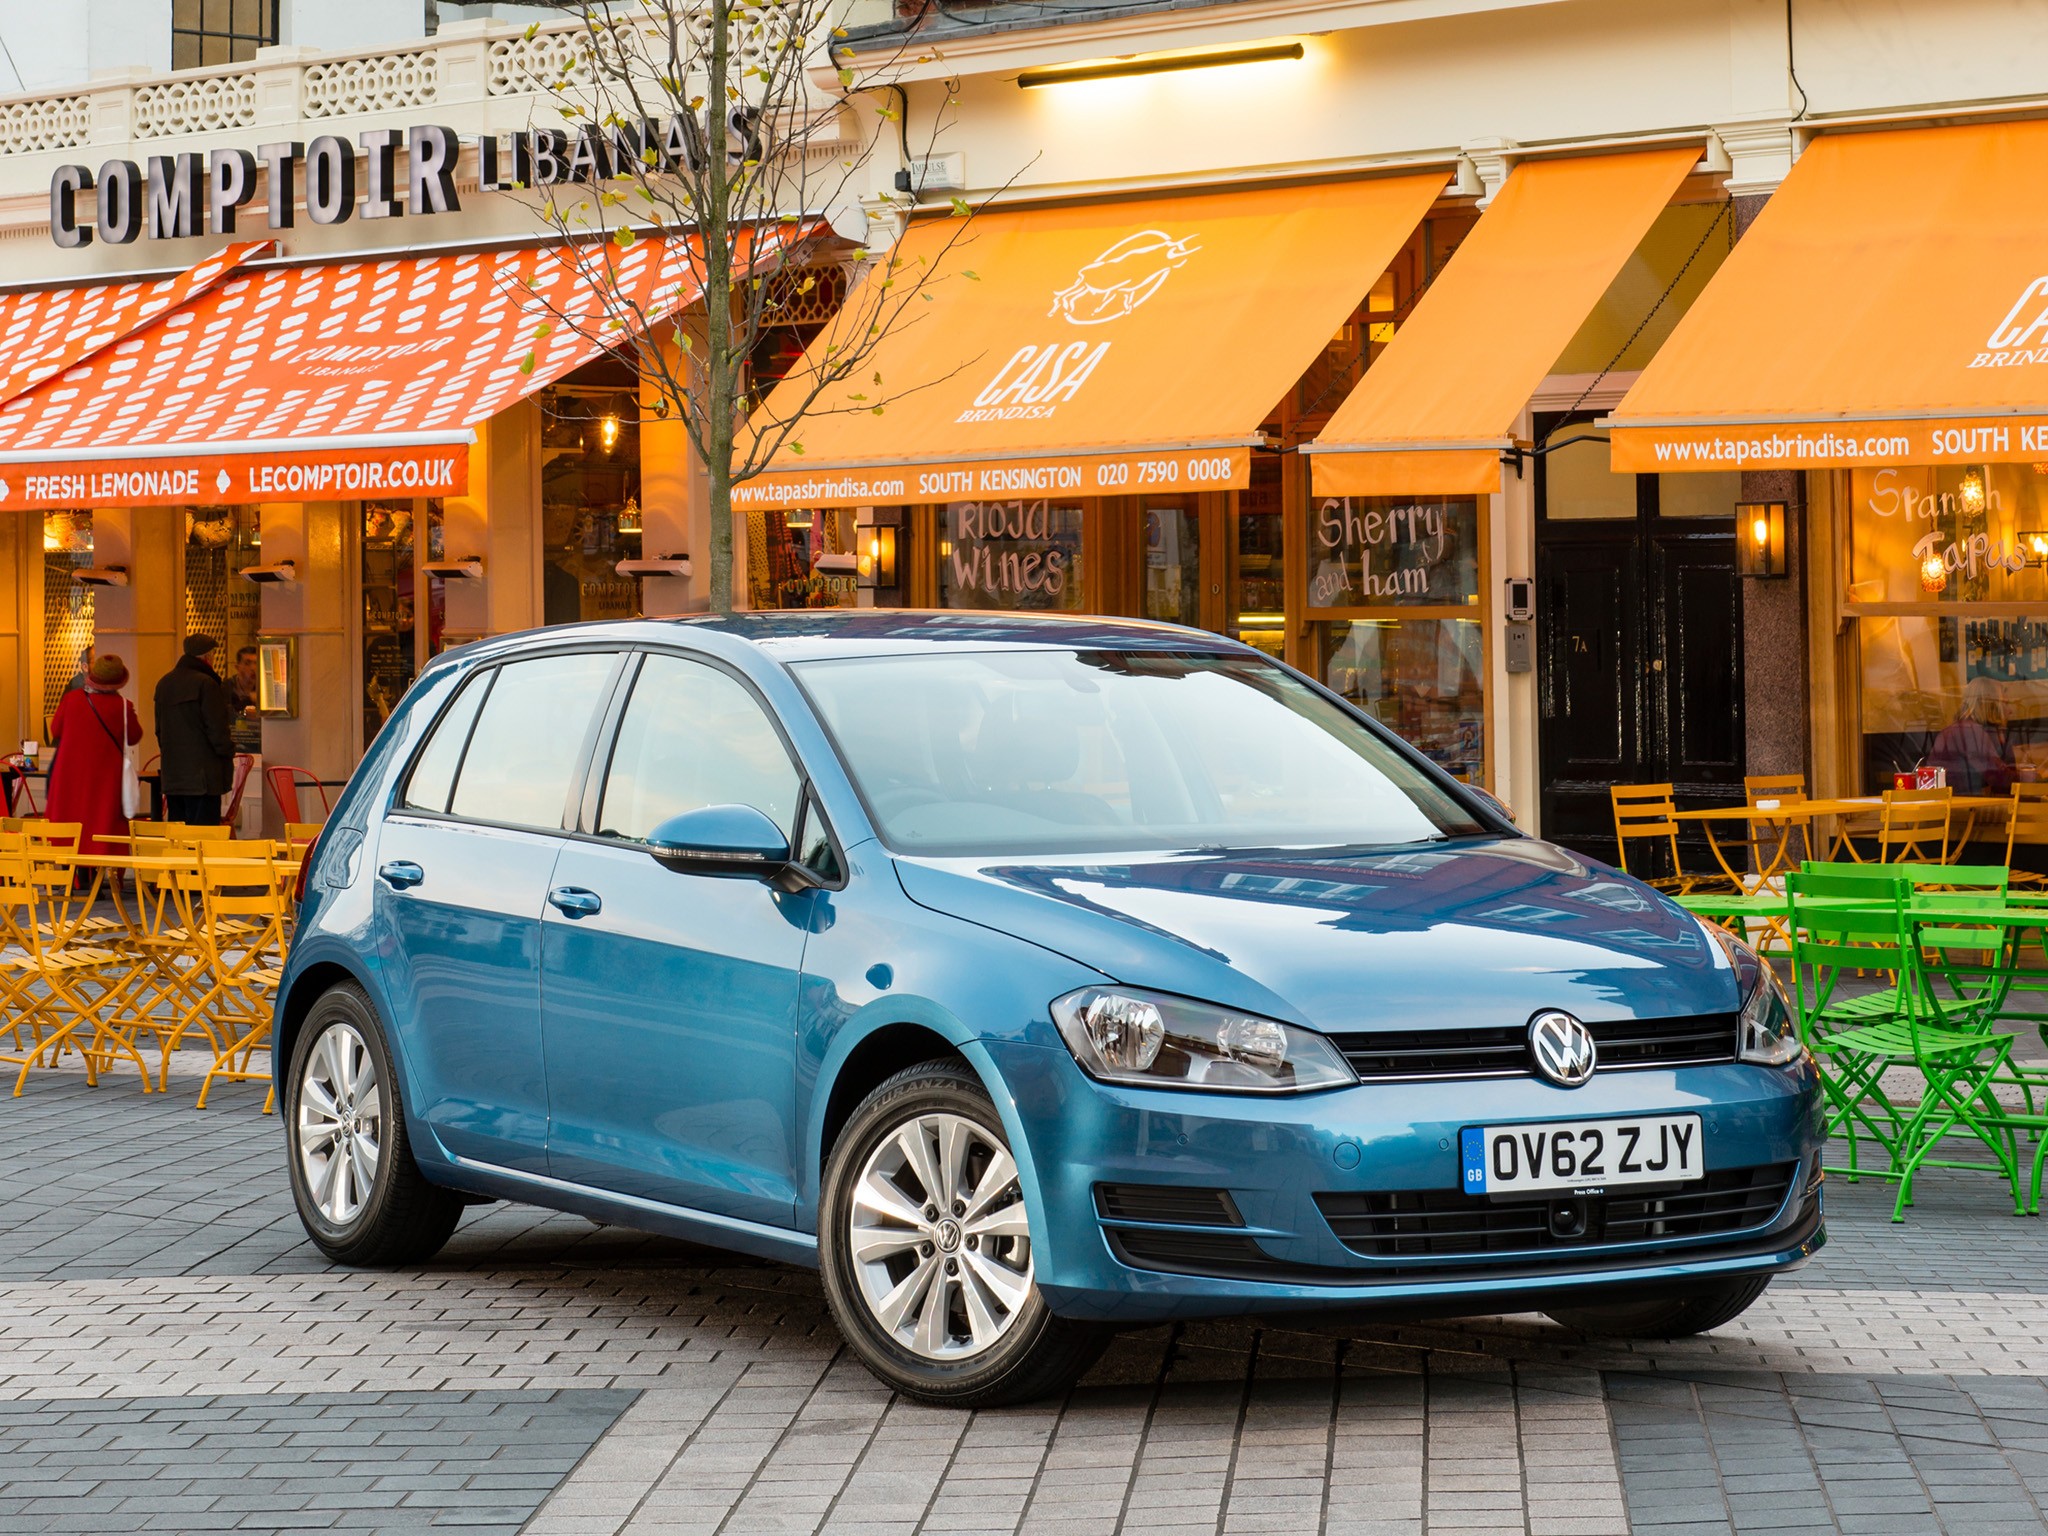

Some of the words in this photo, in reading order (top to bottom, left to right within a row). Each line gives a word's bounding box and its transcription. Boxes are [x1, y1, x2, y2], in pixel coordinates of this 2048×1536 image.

[50, 125, 461, 249] COMPTOIR
[287, 336, 456, 364] COMPTOIR
[298, 363, 384, 376] LIBANAIS
[973, 341, 1112, 407] CASA
[953, 405, 1057, 423] BRINDISA
[1654, 433, 1910, 464] www.tapasbrindisa.com
[1931, 427, 2010, 455] SOUTH
[25, 475, 85, 500] FRESH
[91, 470, 199, 498] LEMONADE
[249, 459, 456, 492] LECOMPTOIR.CO.UK
[919, 470, 973, 494] SOUTH
[980, 467, 1082, 492] KENSINGTON
[1097, 463, 1128, 486] 020
[1137, 460, 1179, 483] 7590
[1187, 458, 1232, 480] 0008
[1318, 497, 1446, 562] Sherry
[1361, 549, 1429, 596] ham
[1912, 531, 2028, 580] Tapas
[870, 1079, 958, 1112] TURANZA
[1492, 1128, 1605, 1181] OV62
[1616, 1123, 1694, 1174] ZJY
[1467, 1168, 1483, 1182] GB
